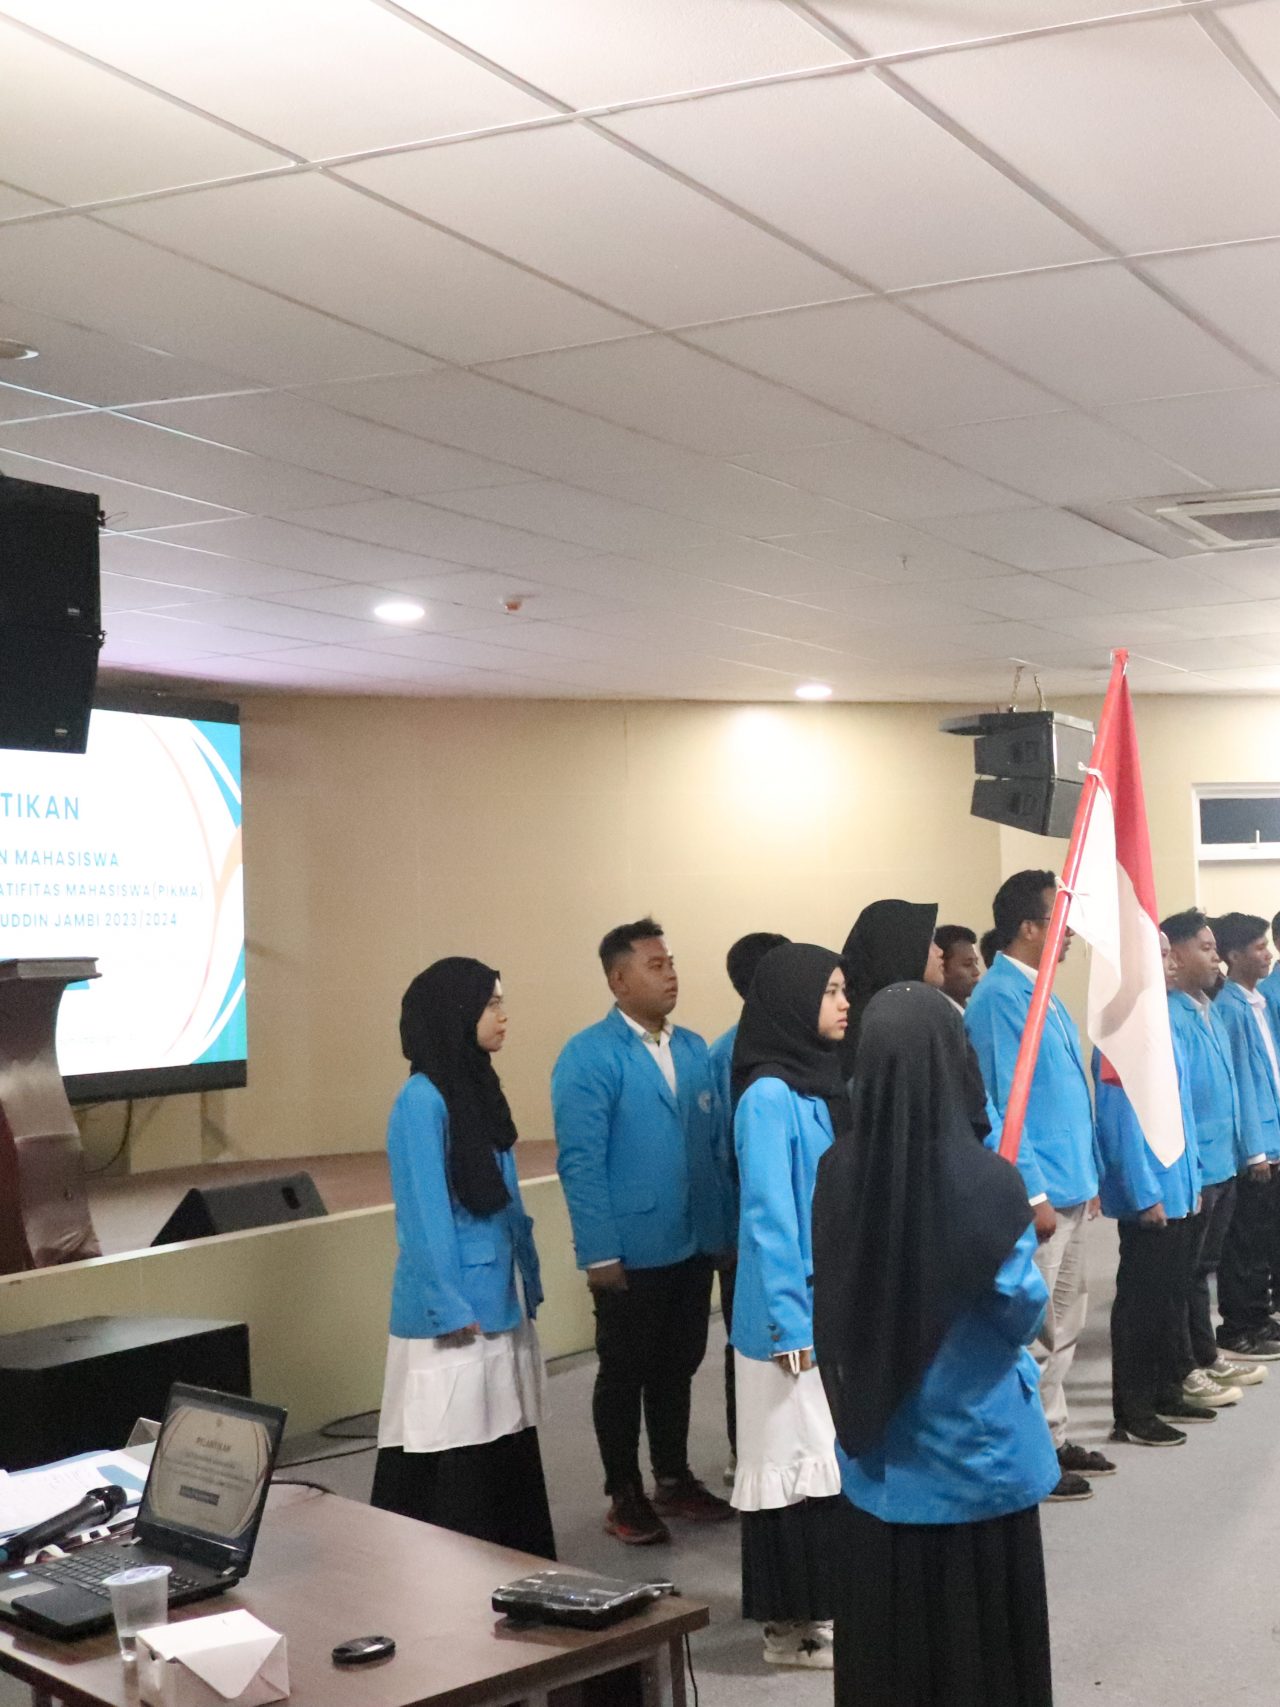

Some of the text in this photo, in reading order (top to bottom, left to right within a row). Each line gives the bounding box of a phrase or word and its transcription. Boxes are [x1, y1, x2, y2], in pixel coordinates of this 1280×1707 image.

[0, 792, 79, 820] TIKAN
[15, 849, 119, 867] MAHASISWA
[0, 910, 177, 928] UDDIN JAMBI 2023/2024
